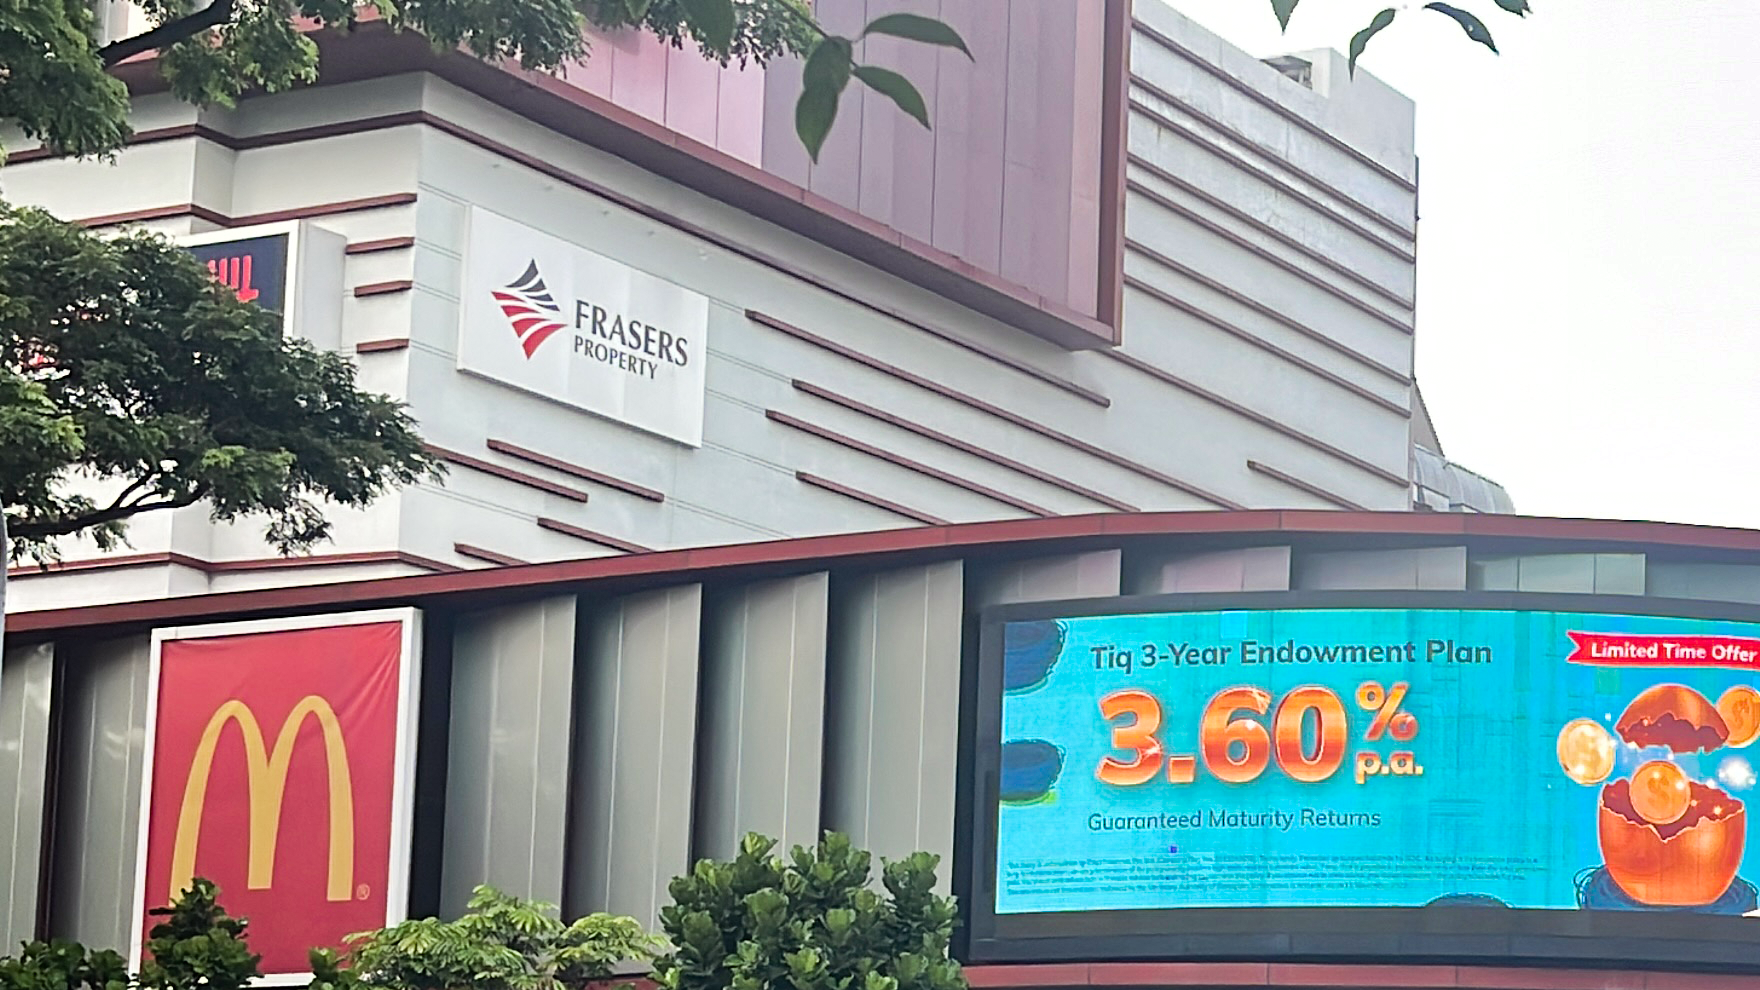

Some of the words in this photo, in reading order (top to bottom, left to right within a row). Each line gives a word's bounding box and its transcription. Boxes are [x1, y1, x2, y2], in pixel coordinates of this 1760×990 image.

[575, 299, 688, 366] FRASERS
[574, 335, 658, 380] PROPERTY
[1091, 645, 1132, 674] Tiq
[1141, 643, 1232, 667] 3-Year
[1241, 640, 1416, 664] Endowment
[1426, 640, 1492, 663] Plan
[1591, 642, 1658, 658] Limited
[1662, 643, 1707, 659] Time
[1712, 645, 1758, 662] Offer
[1355, 752, 1424, 785] p.a.
[1088, 810, 1201, 831] Guaranteed
[1208, 809, 1294, 831] Maturity
[1301, 808, 1381, 827] Returns
